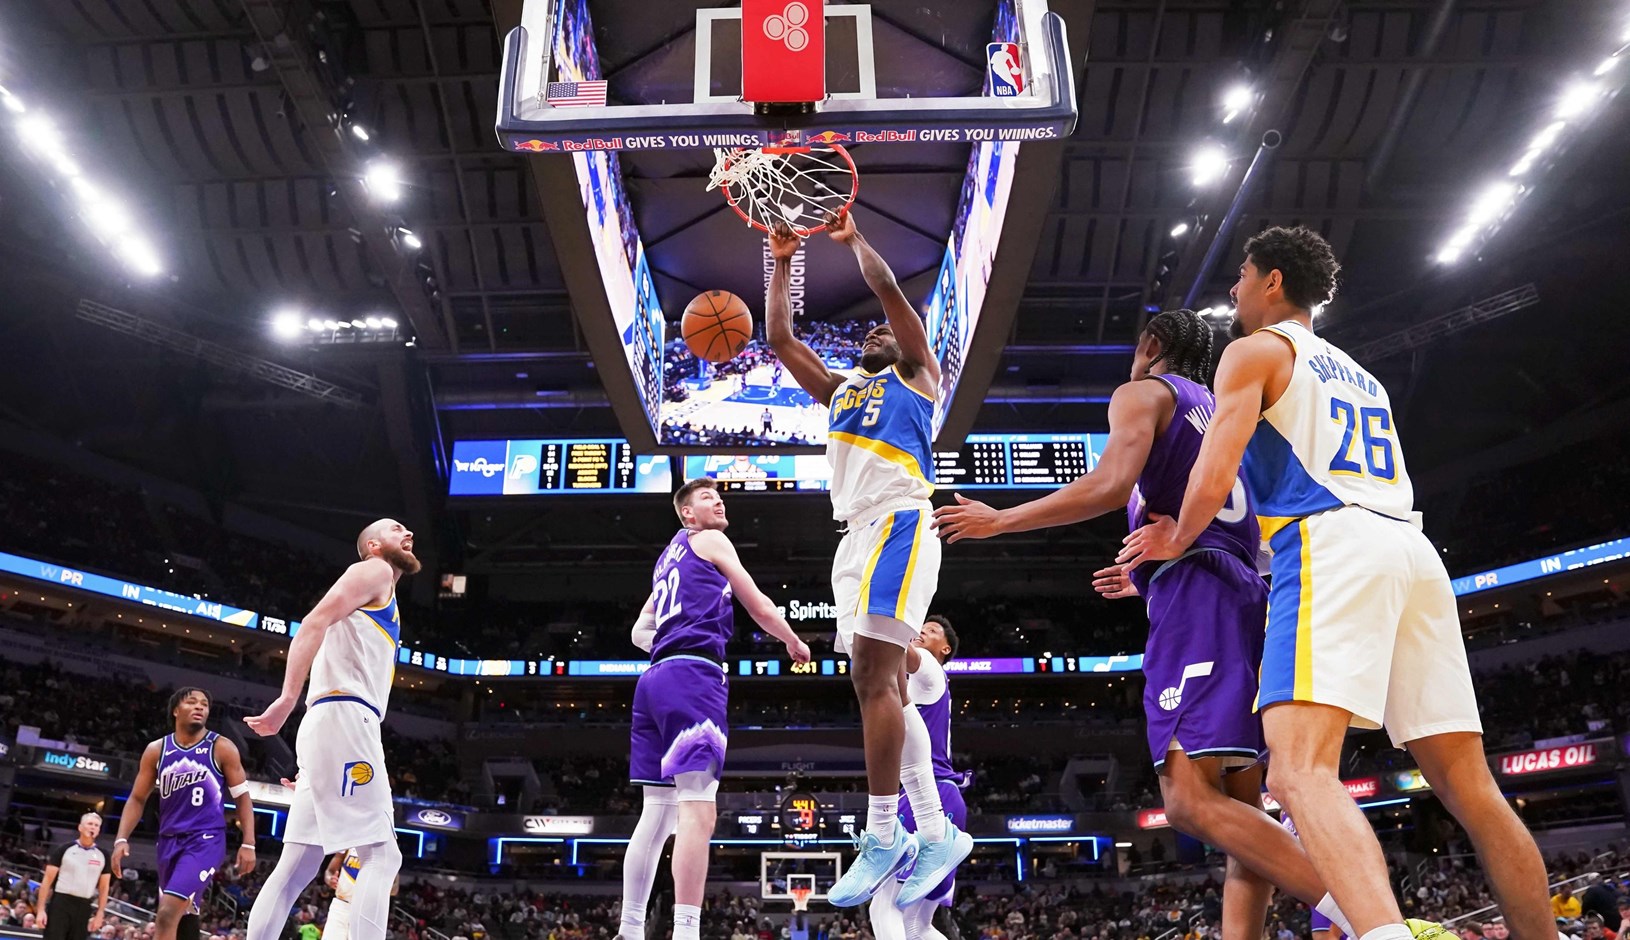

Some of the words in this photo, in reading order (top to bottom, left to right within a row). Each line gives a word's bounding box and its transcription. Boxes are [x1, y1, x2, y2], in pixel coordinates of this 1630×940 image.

[996, 85, 1013, 96] NBA
[625, 136, 665, 149] GIVES
[668, 135, 699, 147] YOU
[703, 134, 764, 148] WIIINGS.
[919, 129, 959, 142] GIVES
[964, 128, 995, 140] YOU
[998, 127, 1057, 140] WIIINGS.
[862, 399, 884, 427] 5
[1329, 397, 1399, 486] 26
[1540, 556, 1562, 574] IN
[122, 583, 140, 600] IN
[653, 567, 682, 630] 22
[790, 600, 838, 622] Spirits
[781, 762, 815, 770] FLIGHT
[1502, 749, 1560, 774] LUCAS
[1565, 745, 1596, 765] OIL
[160, 770, 208, 799] UTAH
[191, 786, 204, 806] 8
[1007, 817, 1074, 830] ticketmaster
